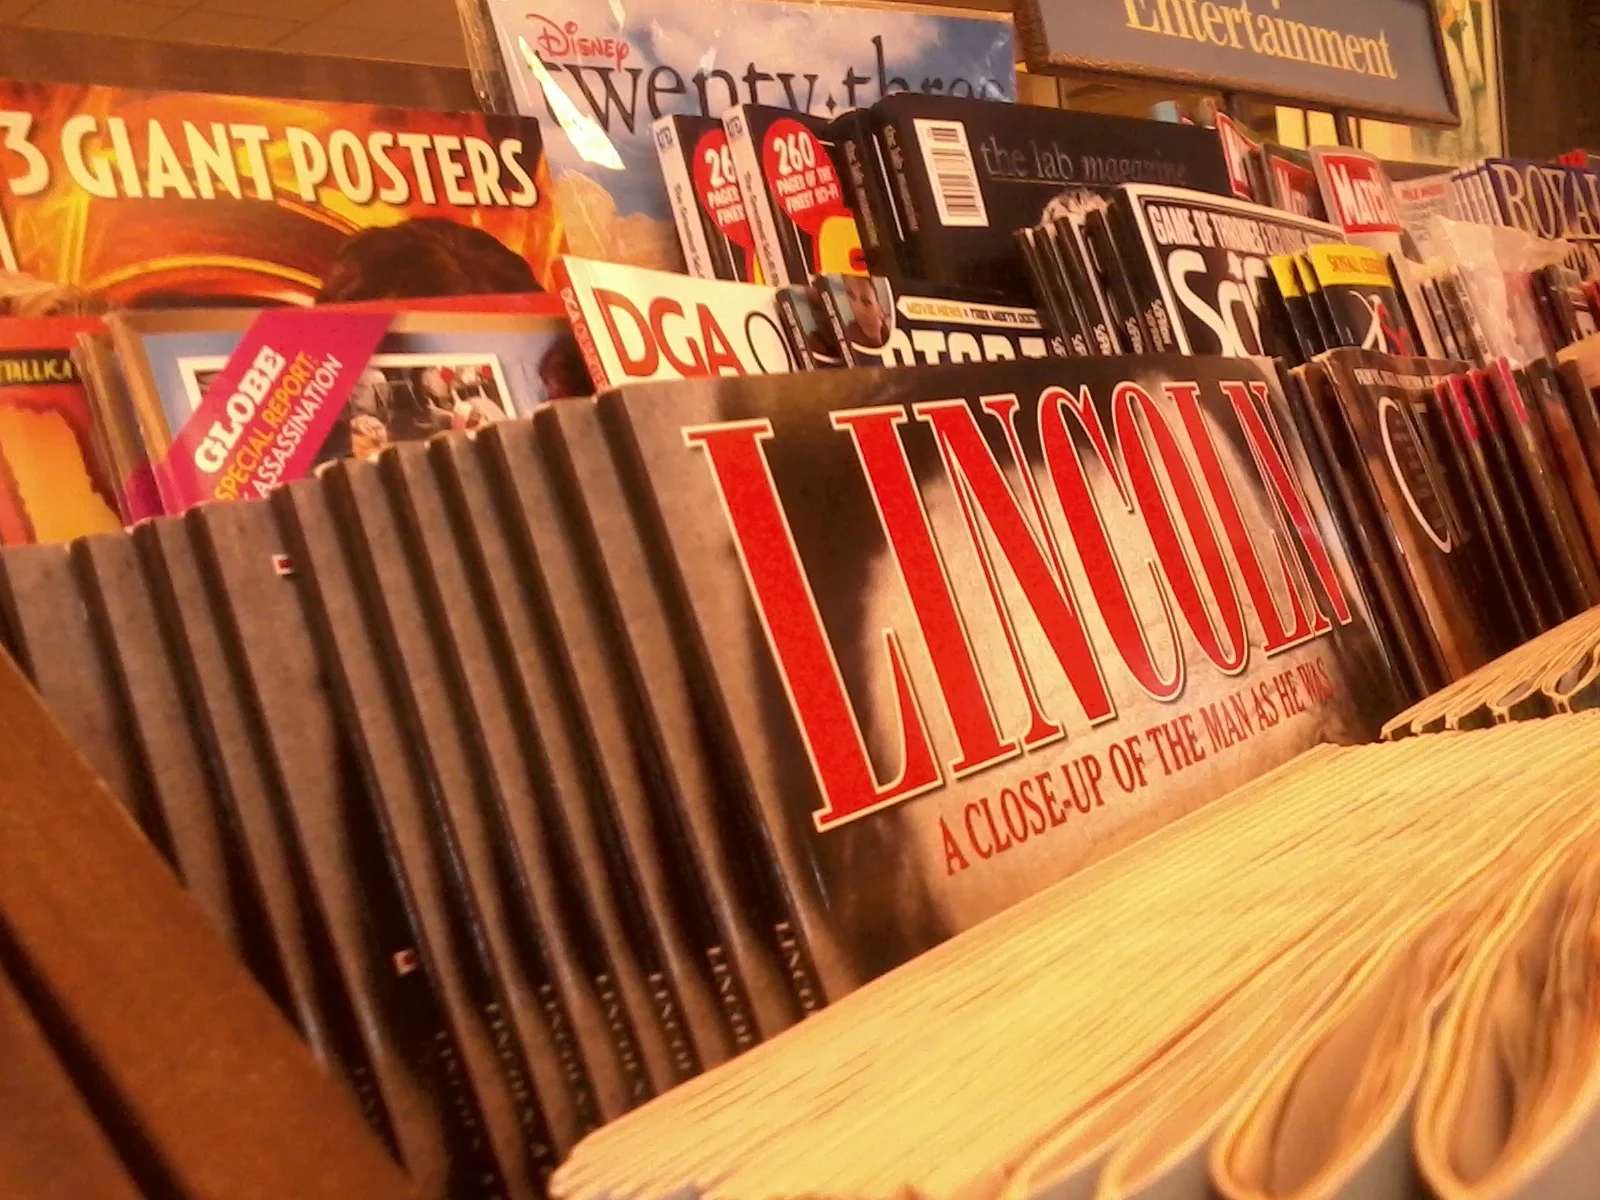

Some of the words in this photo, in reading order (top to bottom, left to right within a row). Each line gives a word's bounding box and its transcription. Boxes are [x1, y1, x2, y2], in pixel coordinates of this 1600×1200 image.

[1126, 0, 1398, 80] Entertainment
[0, 111, 50, 196] 3
[61, 114, 275, 200] GIANT
[286, 127, 538, 208] POSTERS
[773, 131, 816, 176] 260
[981, 136, 1028, 178] the
[1031, 141, 1074, 181] lab
[1147, 205, 1200, 246] GAME
[1191, 209, 1215, 247] OF
[592, 286, 748, 379] DGA
[195, 344, 287, 473] GLOBE
[252, 353, 344, 499] ASSASSINATION
[214, 427, 275, 500] SPECIAL
[682, 380, 1352, 833] LINCOLN
[938, 817, 970, 876] A
[964, 754, 1106, 860] CLOSE-UP
[1108, 735, 1148, 793] OF
[1146, 714, 1207, 776] THE
[1199, 690, 1255, 754] MAN
[1253, 685, 1280, 728] AS
[1273, 672, 1306, 718] HE
[1296, 657, 1334, 703] WAS
